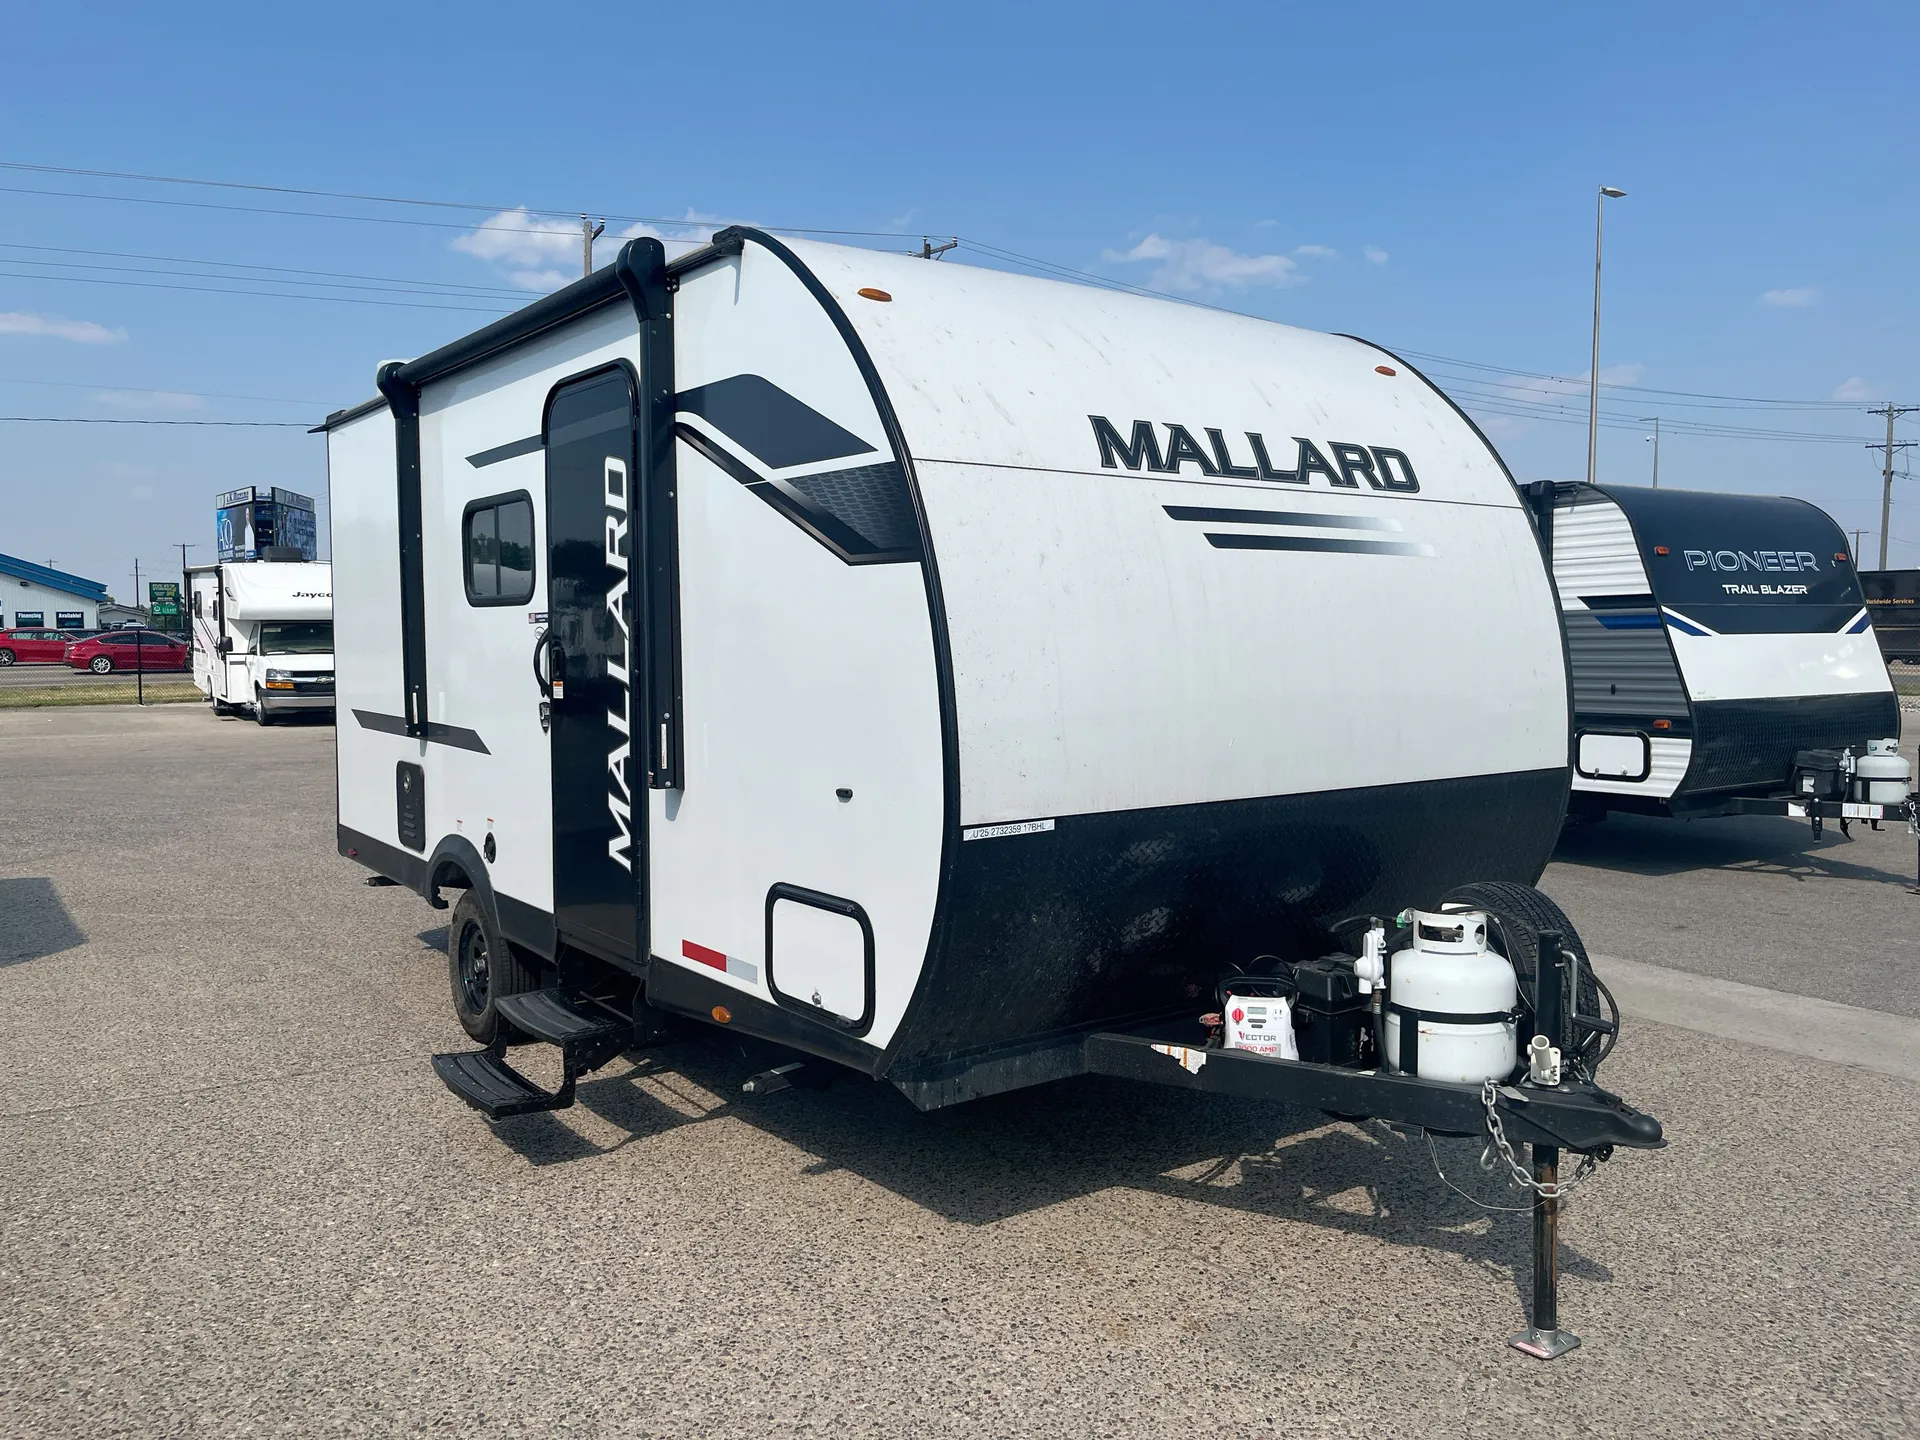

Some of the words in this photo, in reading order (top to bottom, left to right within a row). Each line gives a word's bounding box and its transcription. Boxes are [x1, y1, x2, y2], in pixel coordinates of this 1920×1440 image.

[1087, 414, 1421, 494] MALLARD
[1683, 550, 1821, 572] PIONEER
[292, 591, 333, 599] Jayco
[1721, 584, 1760, 595] TRAIL
[1761, 584, 1808, 595] BLAZER
[604, 455, 632, 875] MALLARD
[991, 824, 1022, 836] 2732359
[1023, 821, 1046, 832] 17BHL
[1238, 1031, 1276, 1041] VECTOR
